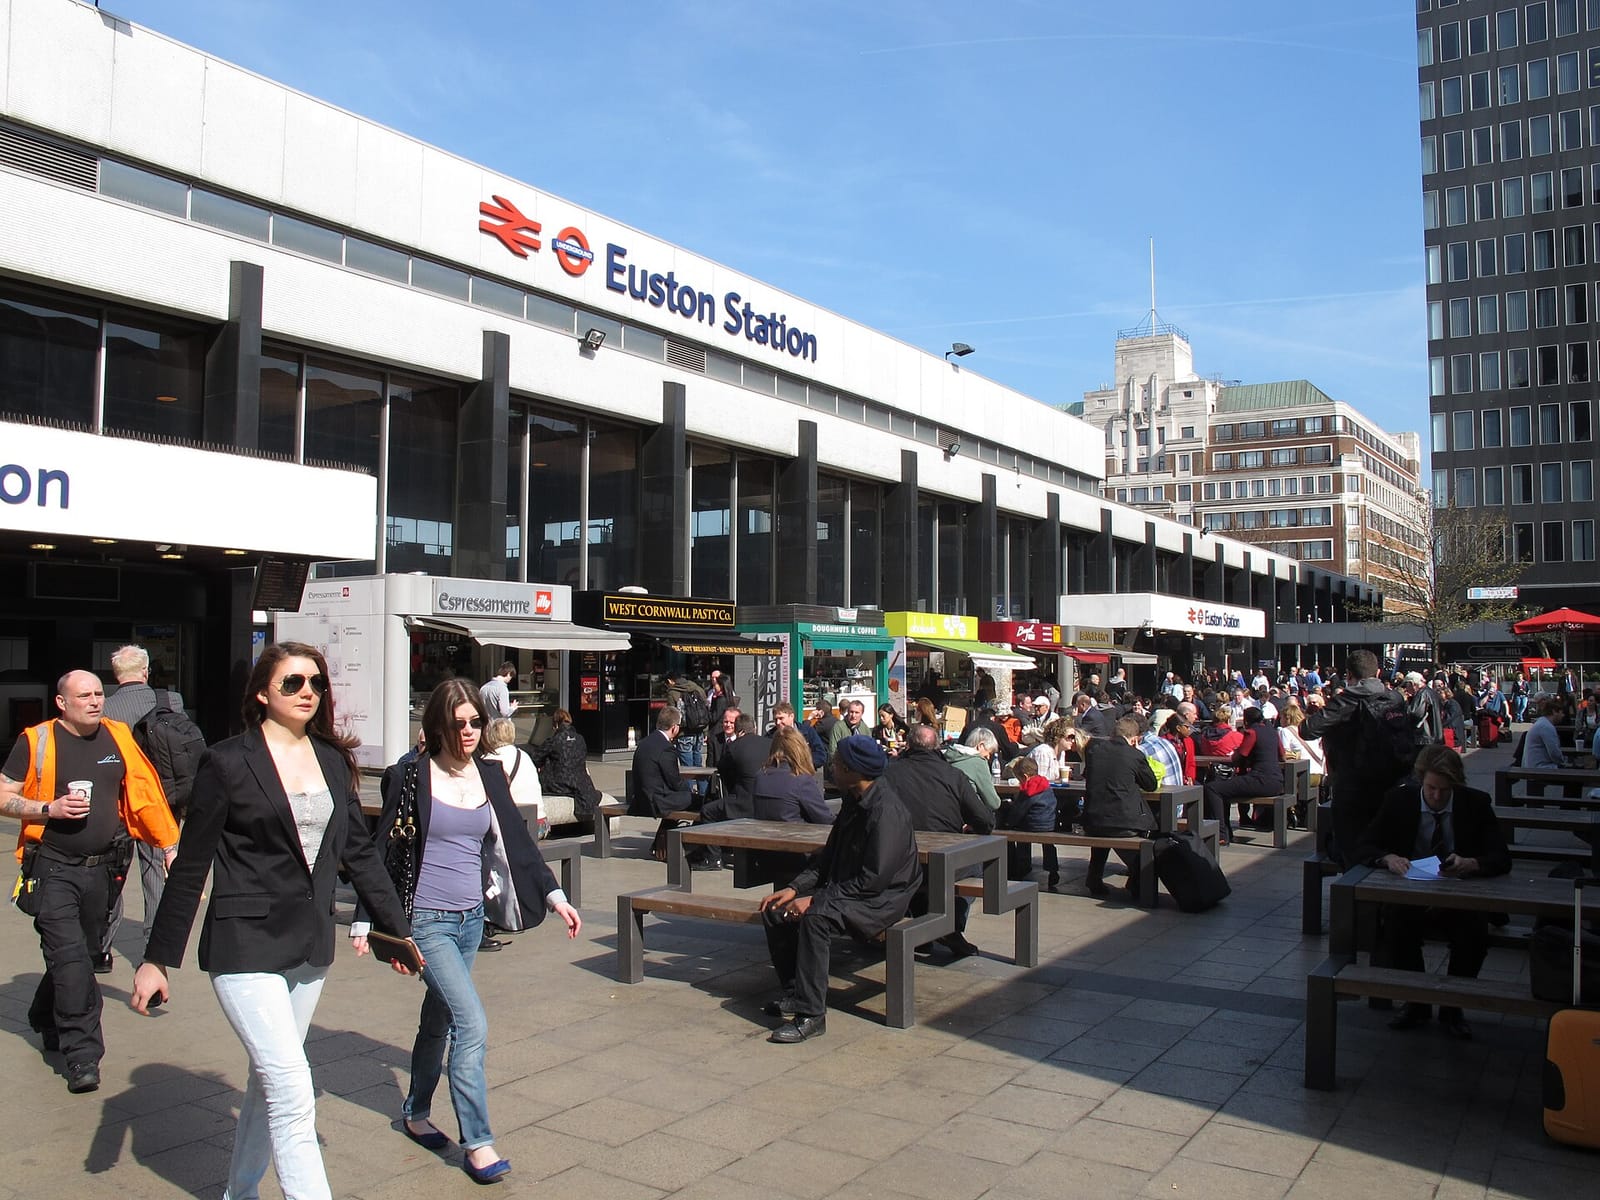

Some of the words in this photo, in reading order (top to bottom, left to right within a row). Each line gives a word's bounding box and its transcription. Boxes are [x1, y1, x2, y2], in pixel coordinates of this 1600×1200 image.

[555, 240, 592, 260] UNDERGROUND
[606, 243, 715, 326] Euston
[724, 292, 817, 362] Station
[537, 594, 551, 611] illy
[609, 602, 637, 616] WEST
[638, 605, 691, 619] CORNWALL
[692, 608, 719, 621] PASTY
[1204, 610, 1222, 627] Euston
[1223, 612, 1240, 629] Station
[812, 624, 849, 634] DOUGHNUTS
[851, 626, 856, 634] &
[857, 626, 877, 635] COFFEE
